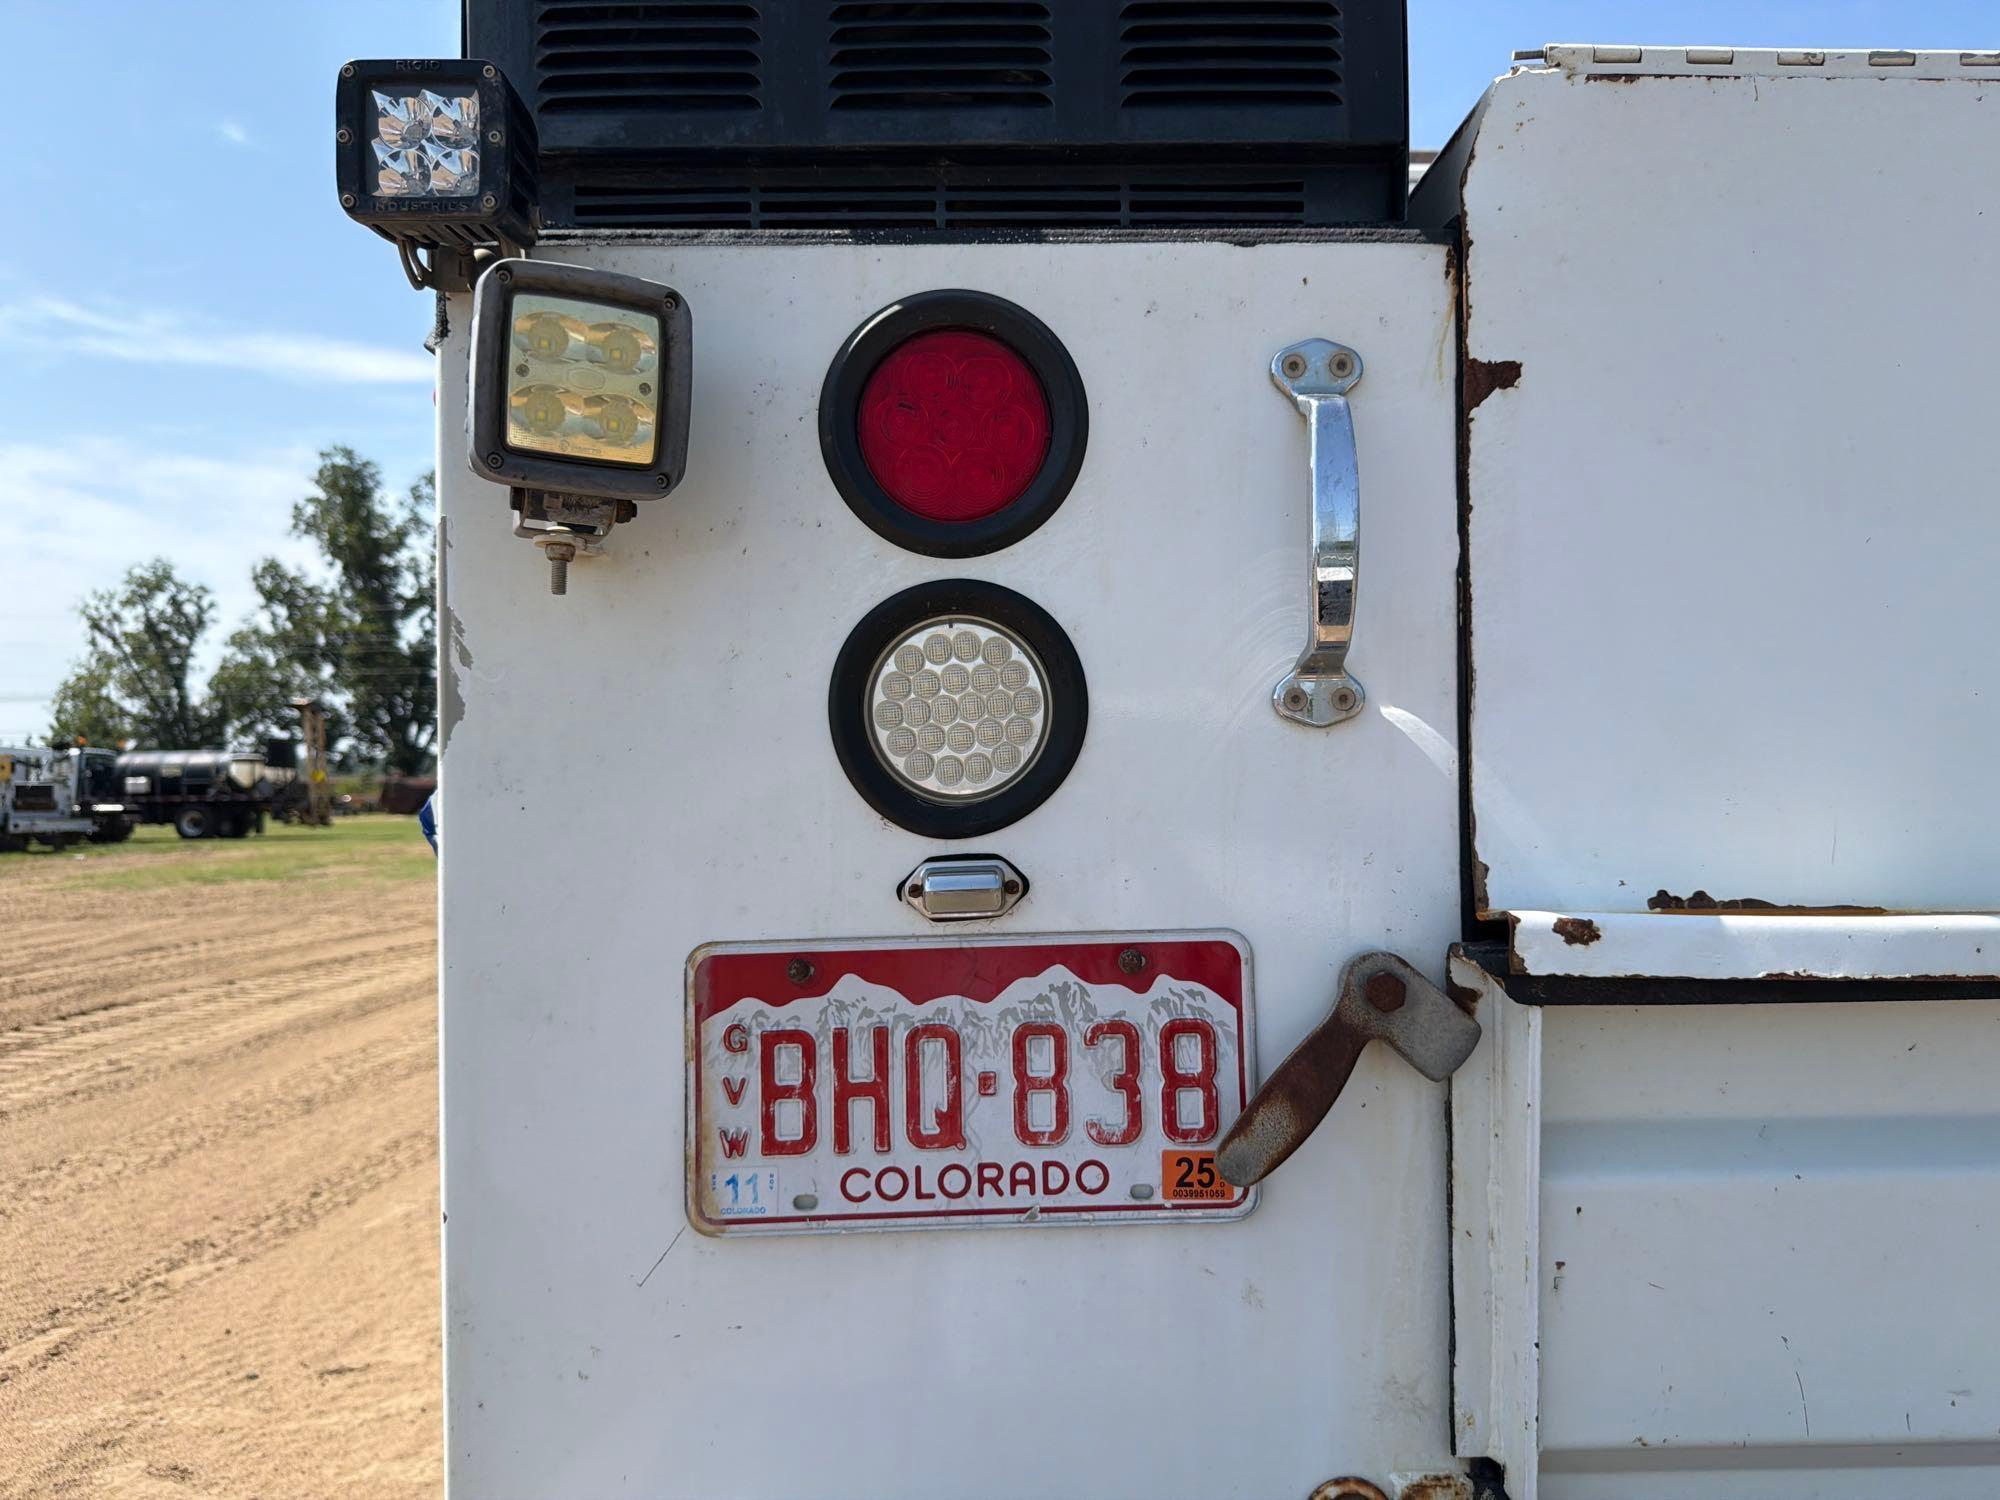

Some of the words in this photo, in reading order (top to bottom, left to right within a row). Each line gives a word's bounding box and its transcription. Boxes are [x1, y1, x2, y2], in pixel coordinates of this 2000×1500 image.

[395, 60, 441, 71] RIGID
[371, 201, 468, 212] INDUSTRIES
[839, 1158, 1110, 1203] COLORADO
[1175, 1156, 1216, 1189] 25
[724, 1172, 759, 1204] 11
[1172, 1188, 1226, 1198] 0039951059
